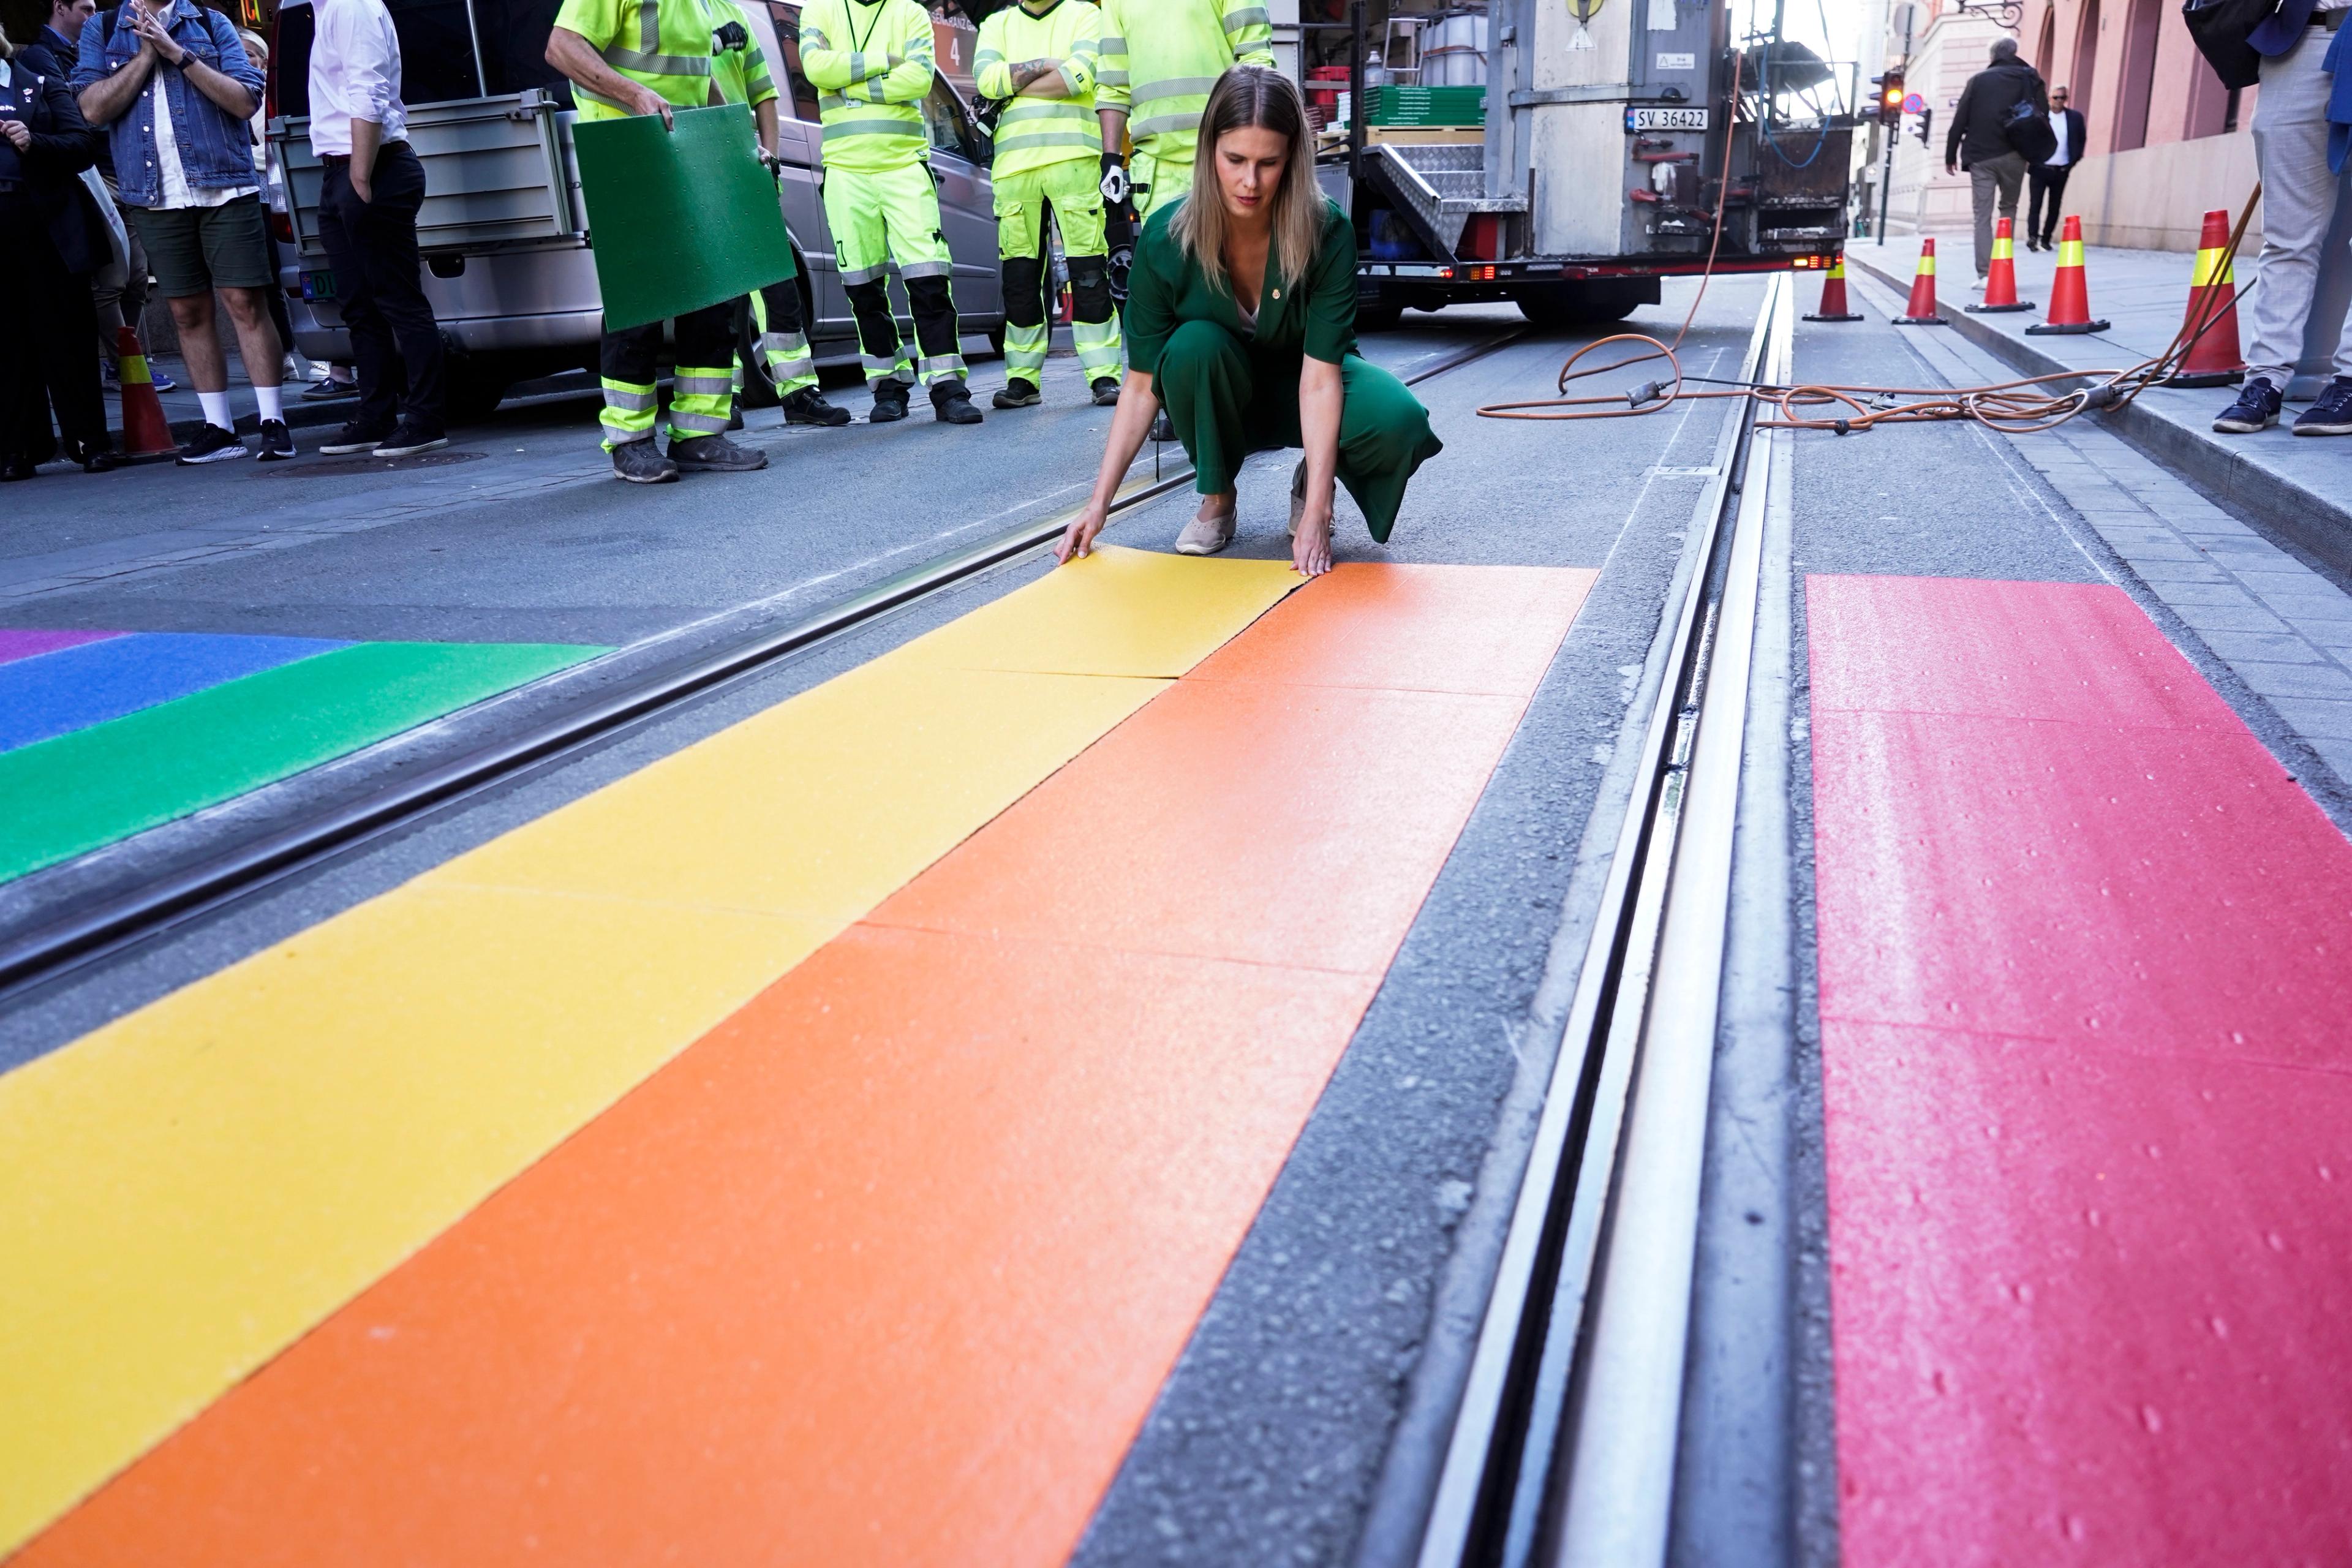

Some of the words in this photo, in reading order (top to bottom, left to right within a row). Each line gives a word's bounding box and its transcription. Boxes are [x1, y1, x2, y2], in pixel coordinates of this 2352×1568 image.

[950, 37, 960, 66] 4
[1638, 111, 1655, 126] SV
[1662, 111, 1703, 126] 36422
